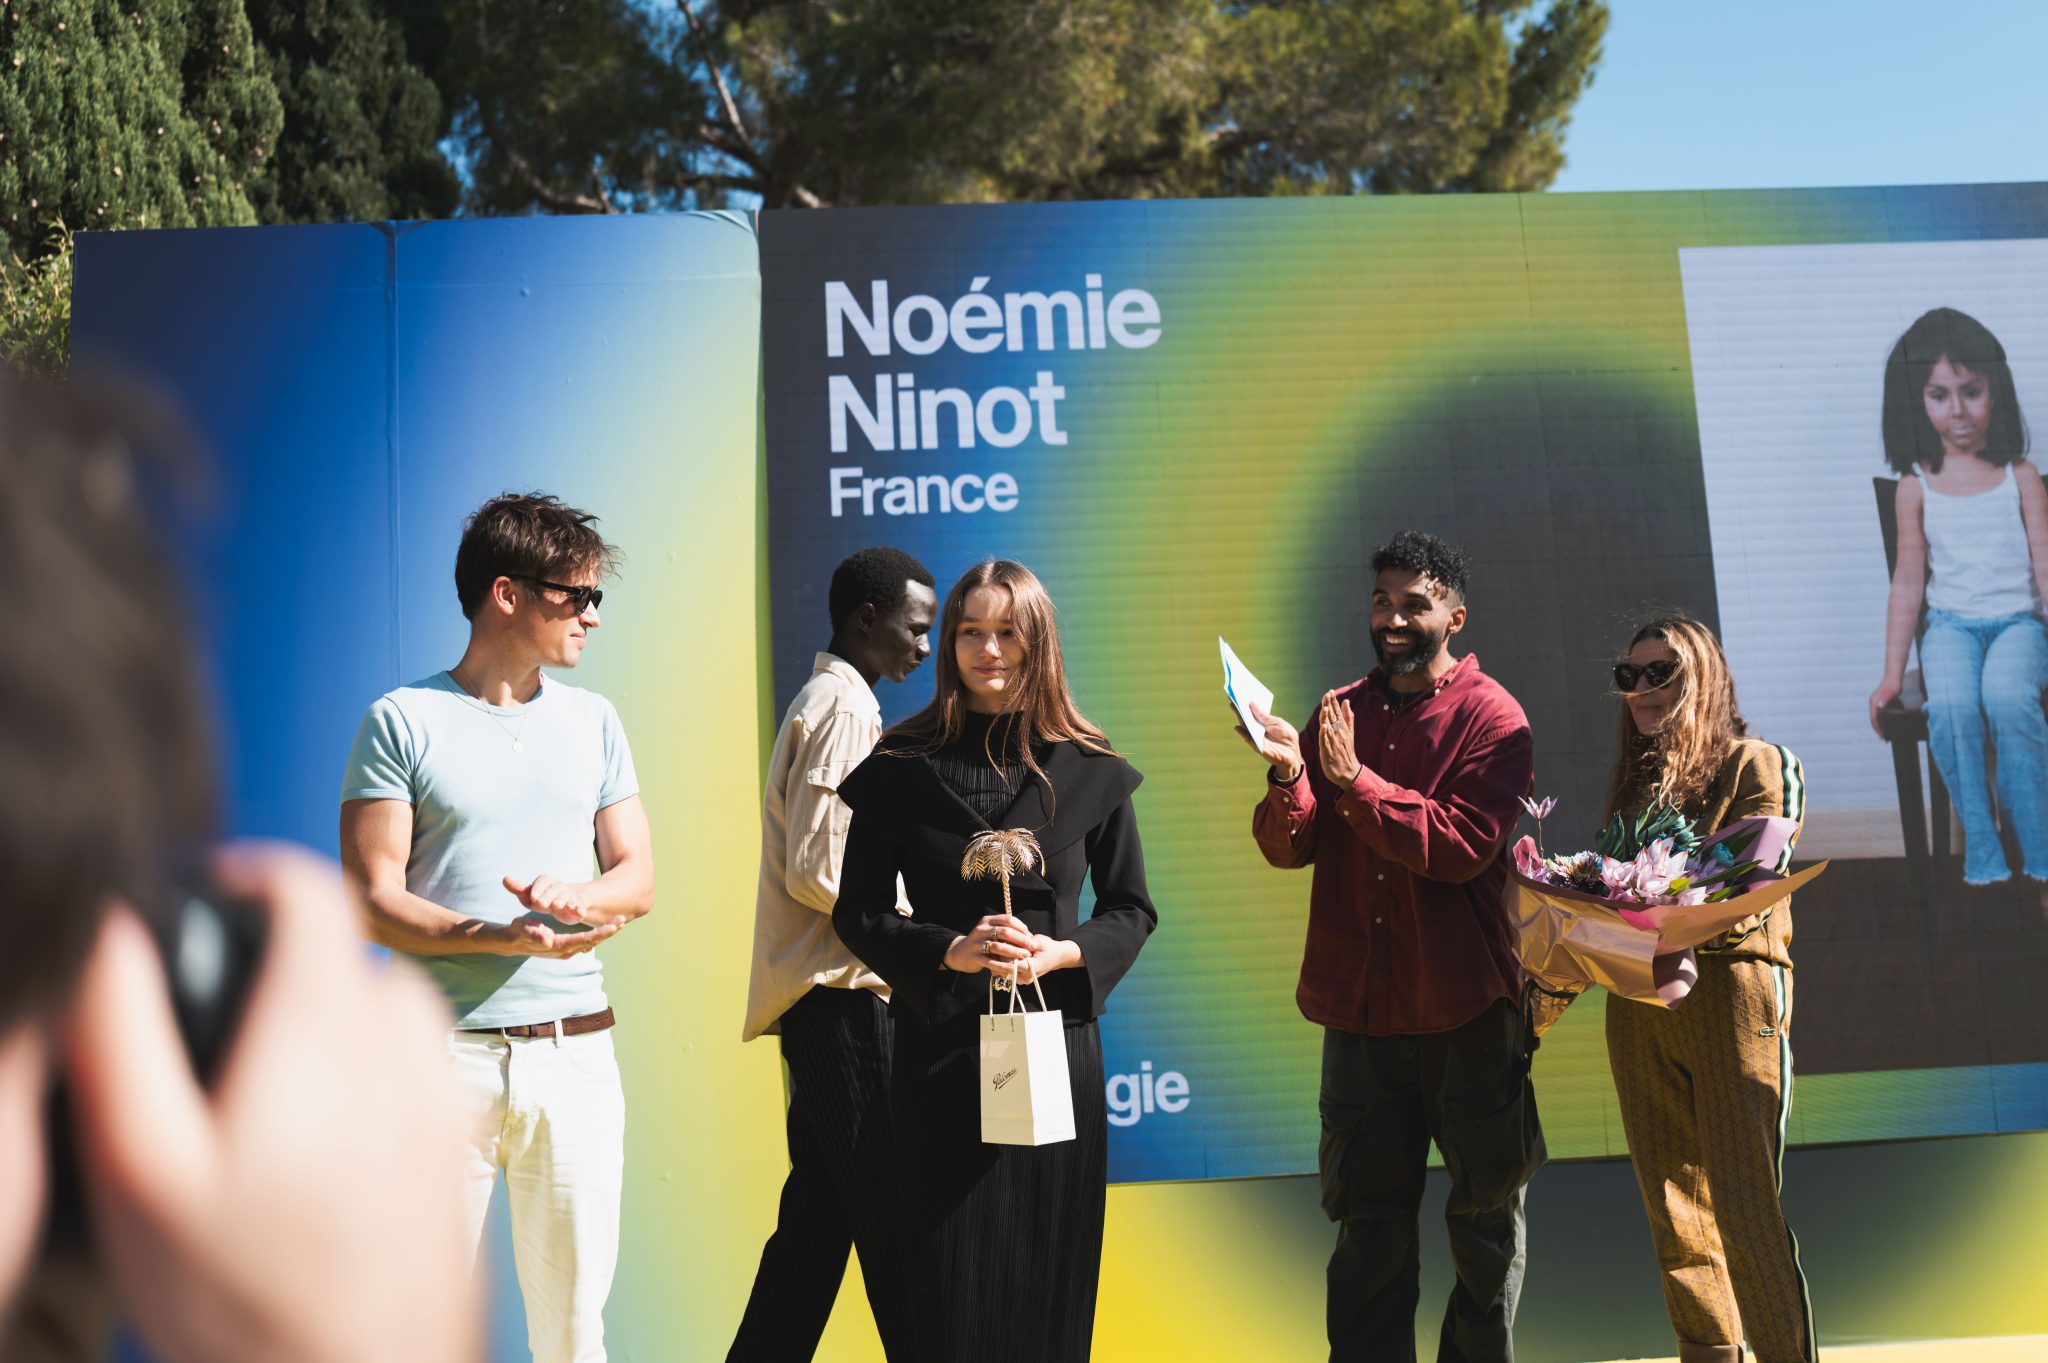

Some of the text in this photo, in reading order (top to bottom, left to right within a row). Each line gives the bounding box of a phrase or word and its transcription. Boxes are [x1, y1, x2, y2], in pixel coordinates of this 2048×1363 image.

[825, 273, 1162, 357] Noémie
[828, 370, 1068, 452] Ninot
[829, 467, 1019, 517] France
[1106, 1060, 1190, 1127] gie
